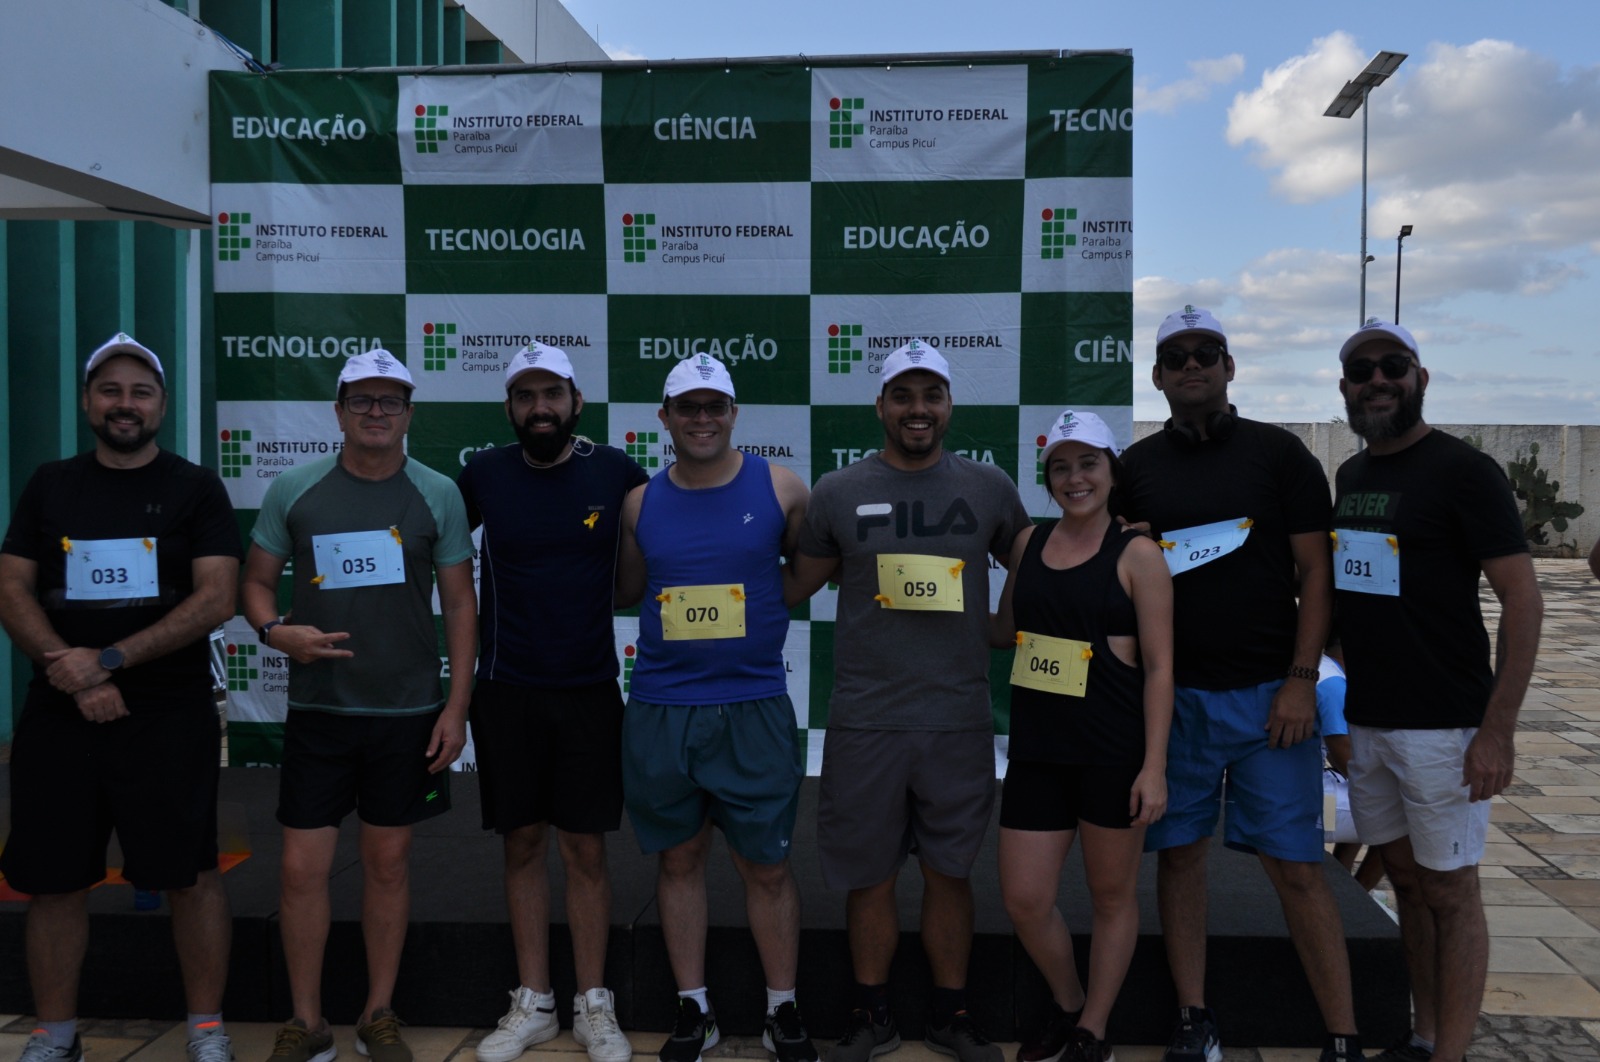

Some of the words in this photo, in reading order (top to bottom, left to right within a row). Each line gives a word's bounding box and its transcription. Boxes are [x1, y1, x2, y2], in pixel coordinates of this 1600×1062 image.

[453, 115, 523, 129] INSTITUTO
[526, 114, 584, 127] FEDERAL
[869, 109, 944, 123] INSTITUTO
[948, 108, 1009, 121] FEDERAL
[232, 114, 366, 147] EDUCAÇÃO
[653, 113, 757, 141] CIÊNCIA
[869, 125, 908, 136] Paraíba
[453, 130, 491, 142] Paraíba
[454, 143, 492, 155] Campus
[495, 142, 518, 154] Picuí
[869, 138, 910, 150] Campus
[912, 137, 936, 149] Picuí
[255, 224, 327, 238] INSTITUTO
[330, 225, 388, 238] FEDERAL
[661, 225, 732, 238] INSTITUTO
[736, 225, 794, 238] FEDERAL
[255, 237, 292, 249] Paraíba
[425, 228, 586, 251] TECNOLOGIA
[843, 221, 990, 255] EDUCAÇÃO
[1082, 236, 1121, 247] Paraíba
[661, 241, 699, 251] Paraíba
[255, 250, 294, 263] Campus
[296, 250, 320, 262] Picuí
[661, 253, 700, 265] Campus
[703, 252, 725, 263] Picuí
[1081, 249, 1122, 262] Campus
[462, 335, 531, 347] INSTITUTO
[944, 335, 1003, 348] FEDERAL
[462, 350, 499, 360] Paraíba
[639, 334, 778, 366] EDUCAÇÃO
[461, 362, 501, 374] Campus
[256, 442, 328, 454] INSTITUTO
[256, 457, 294, 467] Paraíba
[1336, 493, 1390, 517] NEVER
[856, 497, 978, 543] FILA
[1189, 545, 1221, 562] 023
[342, 557, 376, 575] 035
[1344, 558, 1372, 578] 031
[92, 567, 129, 585] 033
[904, 581, 937, 597] 059
[686, 606, 719, 623] 070
[1029, 656, 1060, 676] 046
